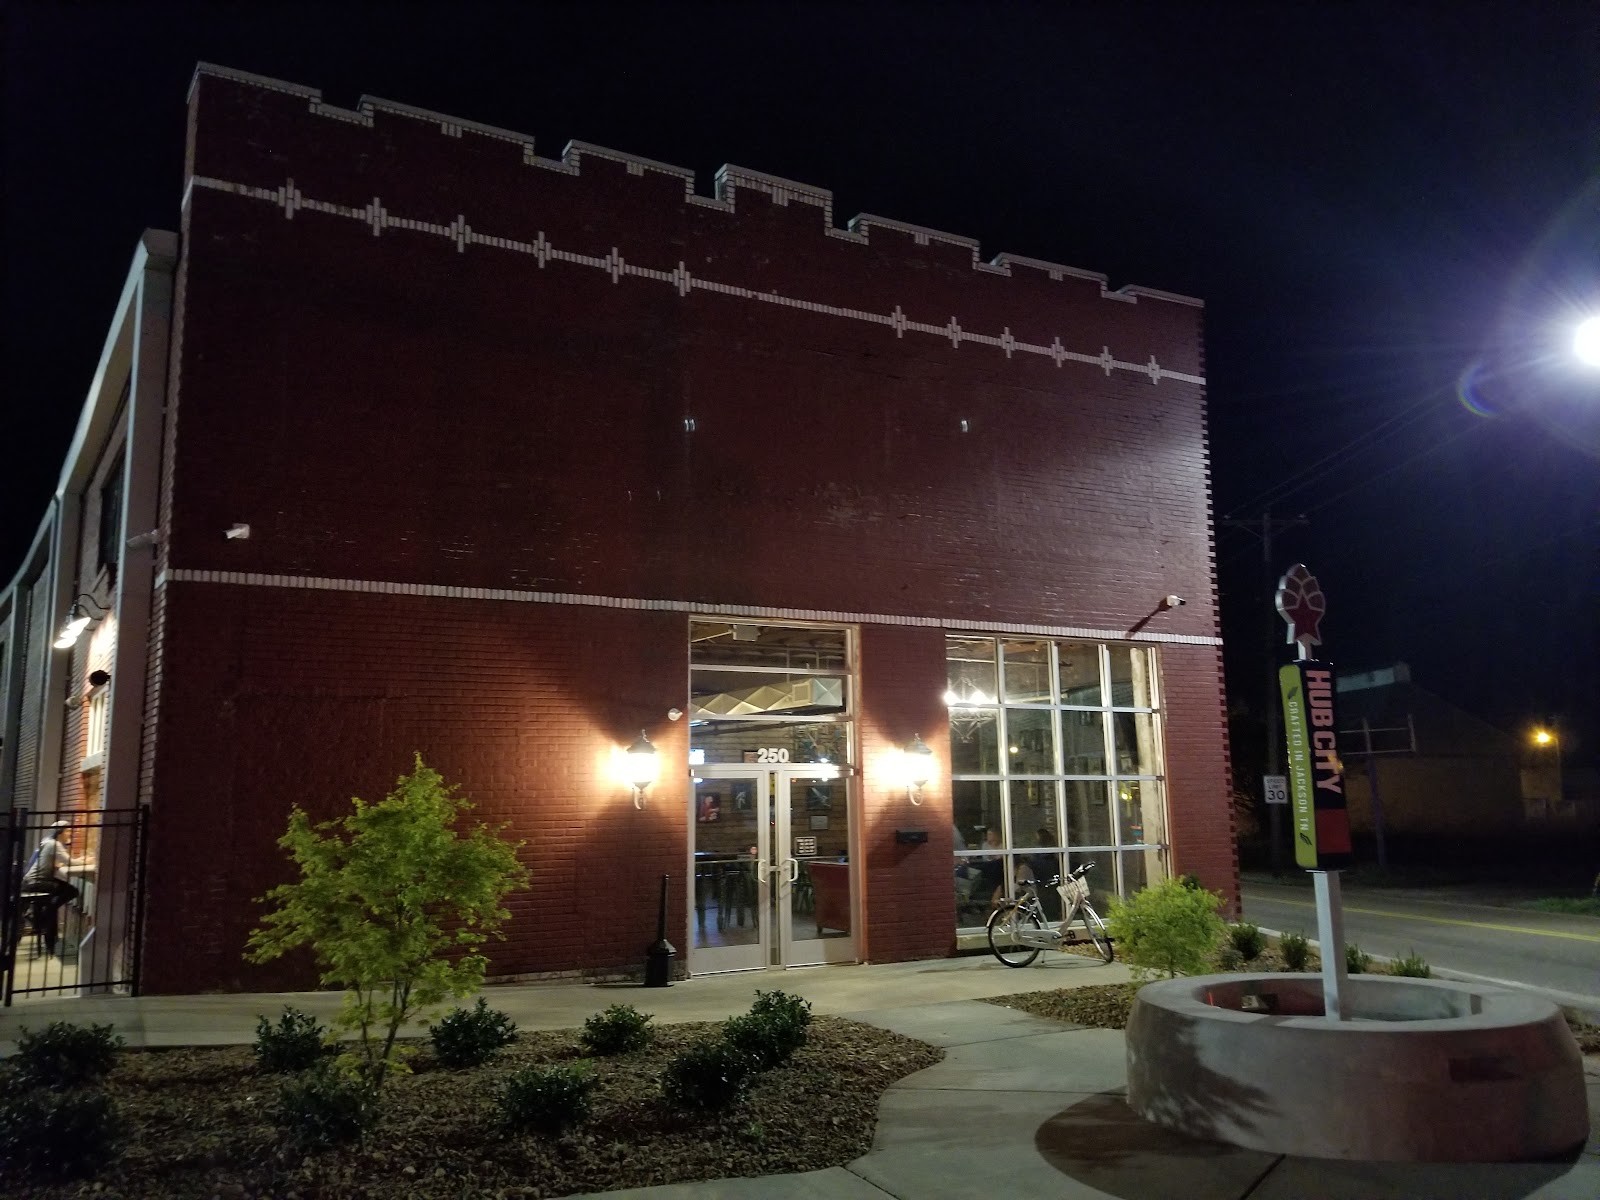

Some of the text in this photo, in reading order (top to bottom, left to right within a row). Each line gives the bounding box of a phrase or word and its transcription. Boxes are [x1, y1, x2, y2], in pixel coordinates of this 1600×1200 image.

[757, 748, 790, 763] 250
[1289, 701, 1309, 831] CRAFTED IN JACKSON TN
[1306, 670, 1343, 794] HUB CITY
[1268, 790, 1285, 801] 30
